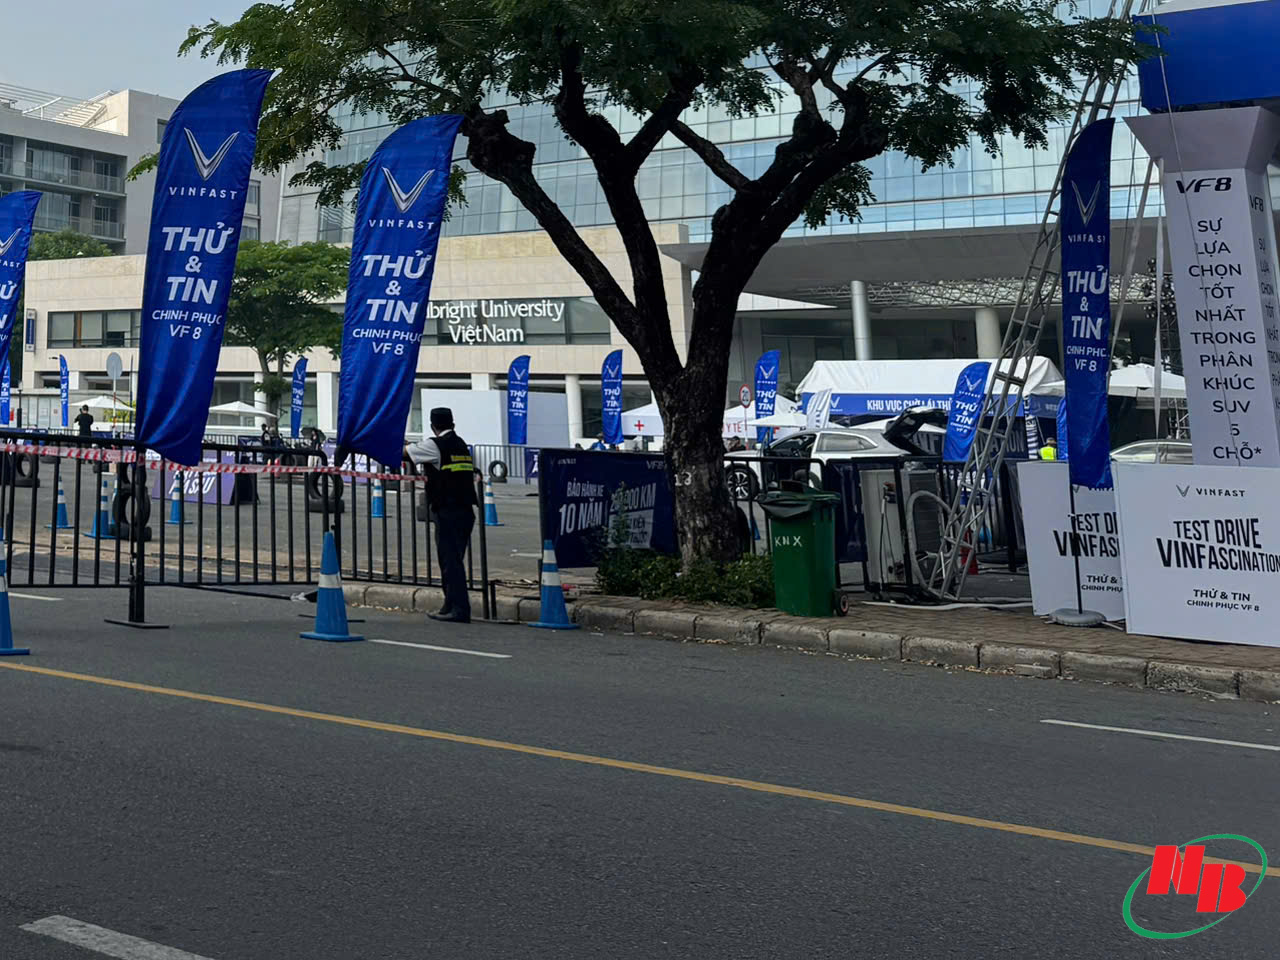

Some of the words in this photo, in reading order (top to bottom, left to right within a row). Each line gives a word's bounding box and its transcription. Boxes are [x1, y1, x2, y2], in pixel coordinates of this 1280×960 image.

[168, 186, 238, 200] VINFAST
[1175, 177, 1232, 194] VF8
[1249, 194, 1264, 212] VF8
[368, 219, 435, 230] VINFAST
[1197, 217, 1223, 235] SỰ
[161, 221, 235, 255] THỬ
[185, 255, 203, 273] &
[362, 249, 433, 280] THỬ
[1188, 263, 1242, 279] CHỌN
[385, 280, 402, 296] &
[1067, 265, 1108, 295] THỬ
[167, 276, 218, 305] TIN
[1199, 281, 1235, 299] TỐT
[366, 298, 419, 324] TIN
[480, 299, 565, 322] University
[1080, 296, 1089, 312] &
[151, 309, 189, 321] CHINH
[1195, 304, 1246, 322] NHẤT
[169, 324, 191, 338] VF
[192, 326, 203, 340] 8
[352, 328, 391, 339] CHINH
[1071, 315, 1103, 340] TIN
[1190, 331, 1256, 344] TRONG
[372, 341, 393, 355] VF
[394, 343, 405, 356] 8
[1074, 358, 1088, 371] VF
[1088, 360, 1097, 372] 8
[1199, 350, 1253, 367] PHÂN
[1203, 373, 1256, 390] KHÚC
[756, 389, 776, 399] THỬ
[511, 401, 525, 409] TIN
[758, 402, 774, 411] TIN
[866, 399, 884, 411] KHU
[885, 399, 902, 413] VỰC
[955, 400, 978, 412] THỬ
[1212, 400, 1251, 413] SUV
[955, 414, 973, 425] TIN
[1230, 423, 1241, 436] 5
[566, 477, 580, 497] BẢO
[1195, 487, 1246, 498] VINFAST
[640, 482, 657, 509] KM
[558, 503, 576, 536] 10
[577, 498, 603, 531] NĂM
[1173, 520, 1210, 542] TEST
[1214, 518, 1262, 549] DRIVE
[1156, 537, 1280, 573] VINFASCINATION
[1086, 574, 1109, 584] THỬ
[1110, 576, 1118, 584] &
[1081, 584, 1105, 592] CHINH
[1193, 588, 1219, 599] THỬ
[1220, 592, 1228, 600] &
[1231, 591, 1251, 602] TIN
[1186, 599, 1214, 608] CHINH
[1215, 602, 1240, 612] PHỤC
[1240, 603, 1253, 611] VF
